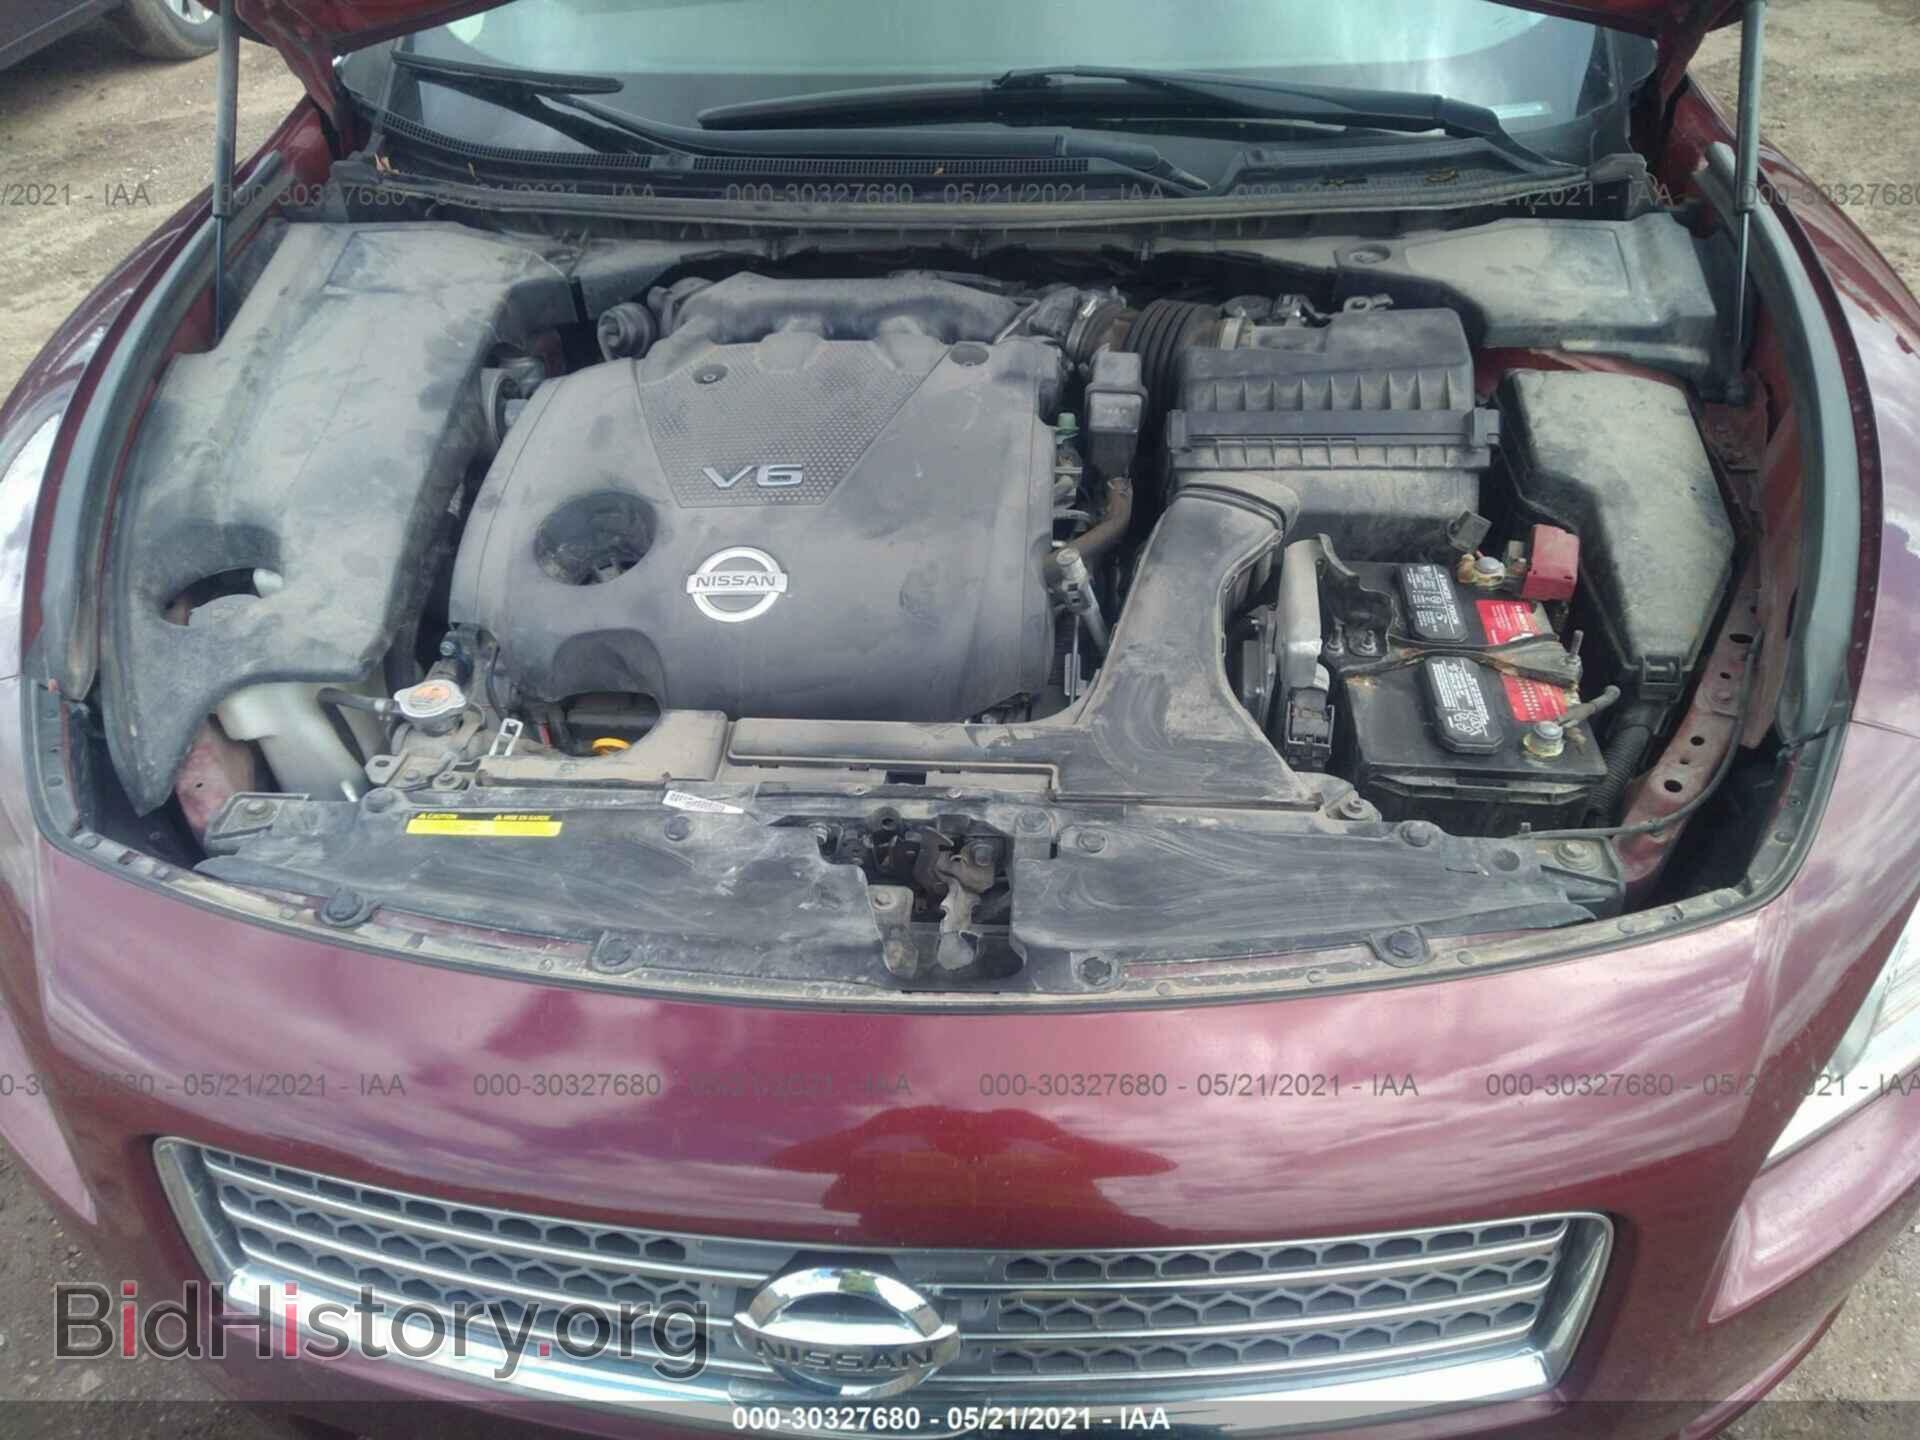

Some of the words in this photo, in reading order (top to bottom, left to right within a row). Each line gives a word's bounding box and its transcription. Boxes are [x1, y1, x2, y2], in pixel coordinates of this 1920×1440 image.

[702, 464, 804, 490] V6
[695, 574, 777, 588] NISSAN
[754, 1337, 937, 1372] NISSAN
